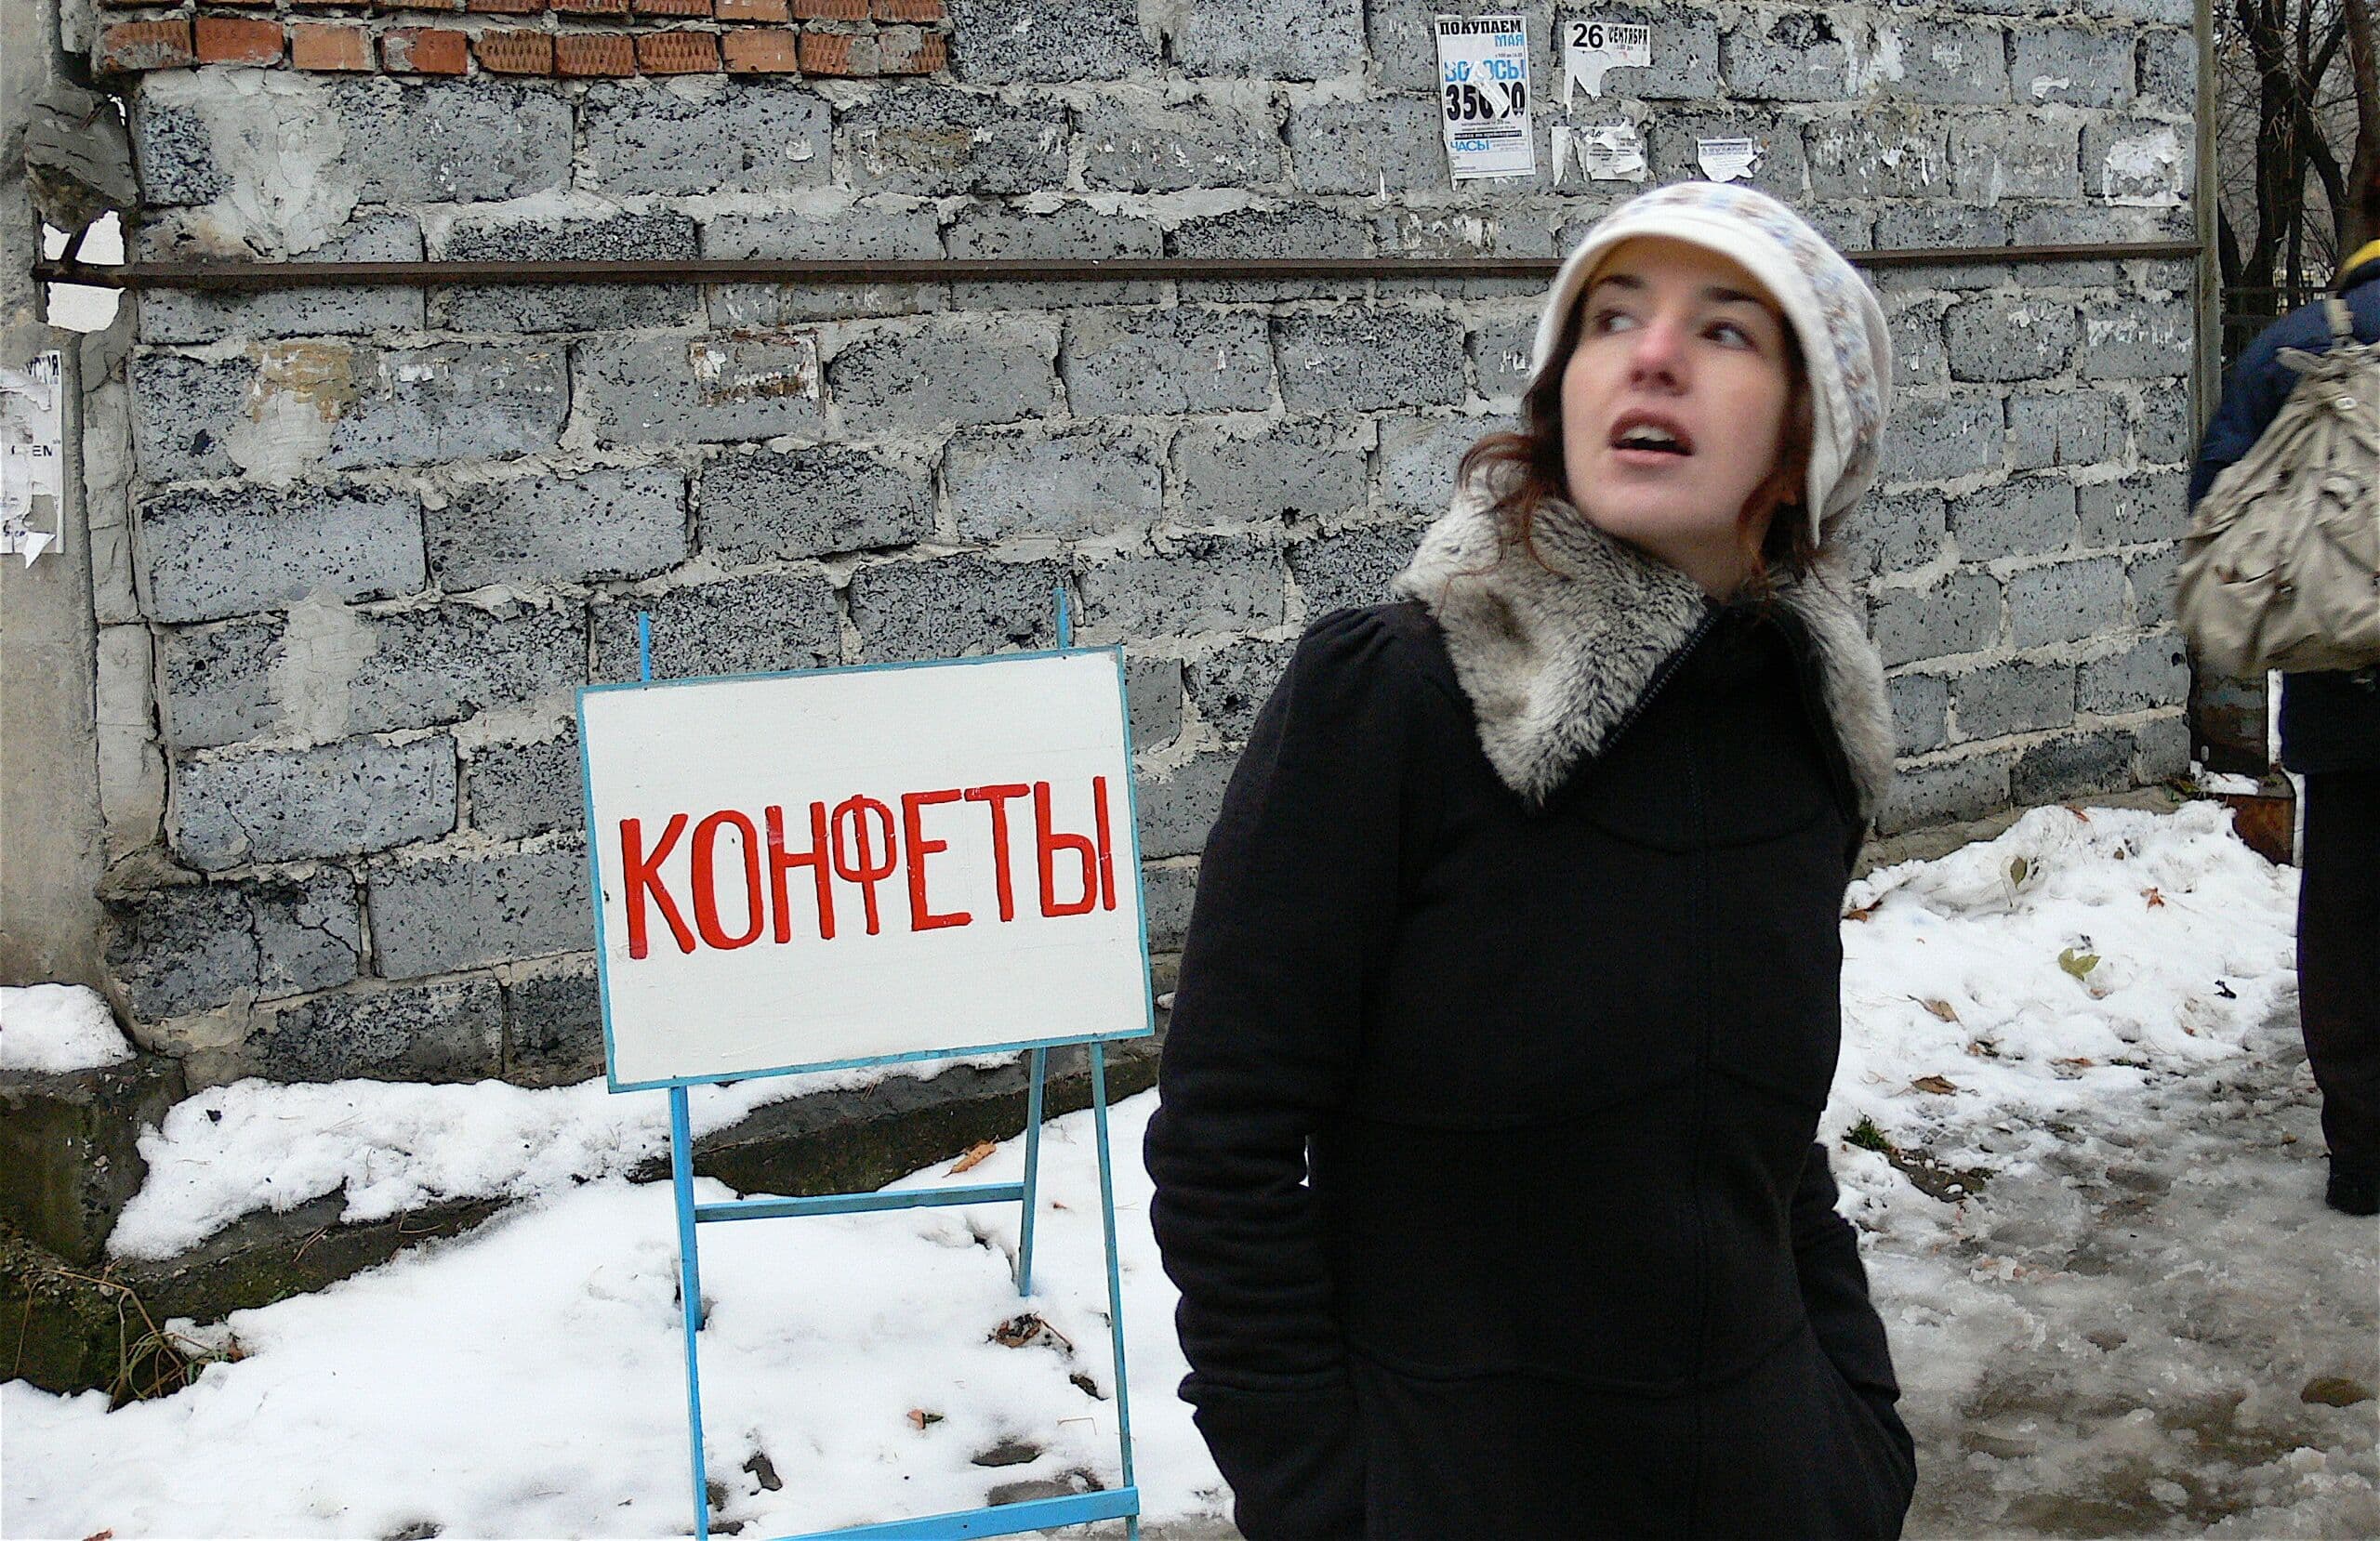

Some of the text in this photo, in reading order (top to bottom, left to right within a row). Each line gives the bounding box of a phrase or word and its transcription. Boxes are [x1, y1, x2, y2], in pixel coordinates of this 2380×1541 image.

[1439, 20, 1522, 35] ПОКУПАЕМ
[1572, 23, 1647, 48] 26 СЕНТЯБРЯ
[1494, 33, 1526, 47] МАЯ
[1444, 59, 1526, 83] ВООСЫ
[1450, 138, 1489, 151] ЧАСЫ
[619, 776, 1117, 960] КОНФЕТЫ
